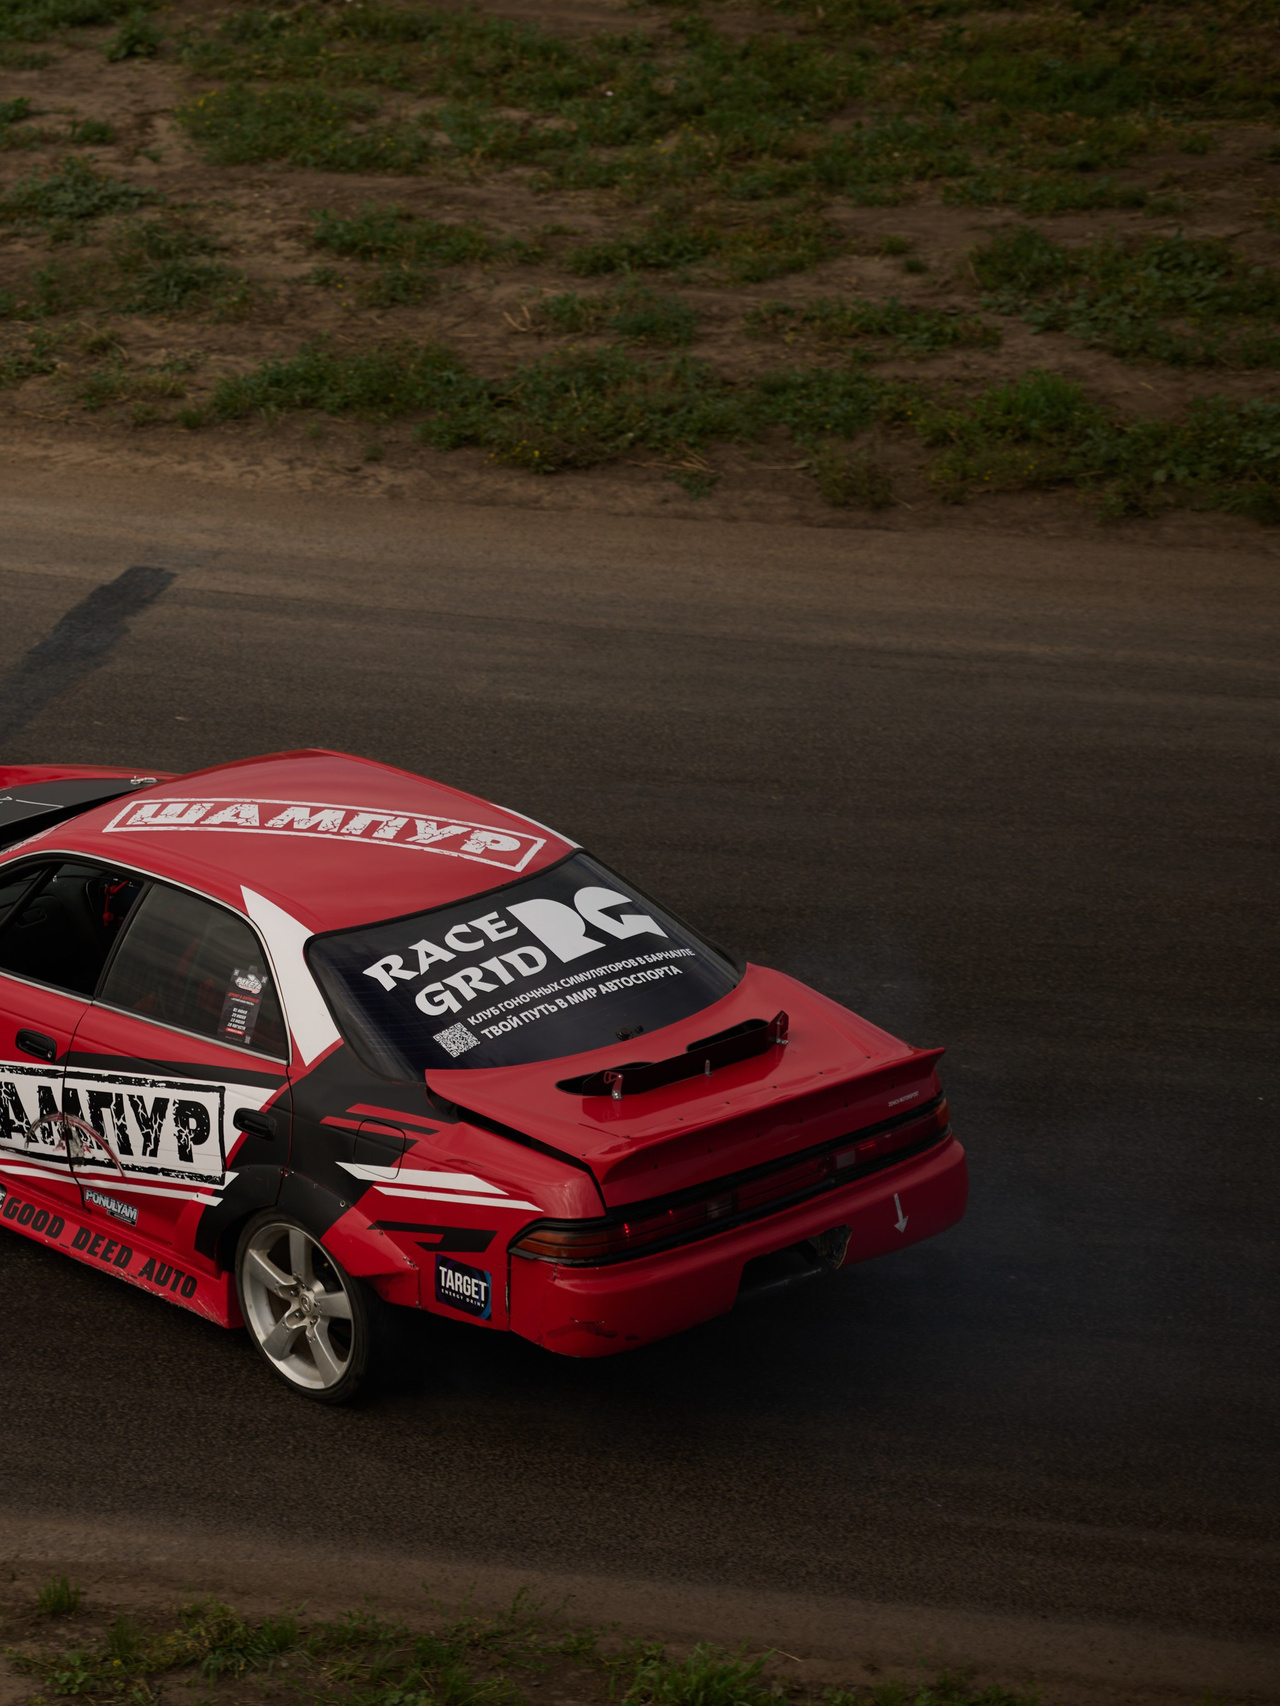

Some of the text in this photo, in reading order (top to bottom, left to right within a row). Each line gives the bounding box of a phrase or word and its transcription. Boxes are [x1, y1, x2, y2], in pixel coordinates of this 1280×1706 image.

[126, 803, 521, 855] ШАМПУР
[362, 911, 519, 992] RACE
[415, 945, 548, 1017] GRID
[467, 948, 696, 1026] КЛУБ ГОНОЧНЫХ СИМУЛЯТОРОВ В БАРНАУЛЕ
[480, 964, 684, 1040] ТВОЙ ПУТЬ В МИР АВТОСПОРТА
[85, 1189, 138, 1221] PONULYAM
[439, 1265, 489, 1302] TARGET
[441, 1288, 485, 1309] ENERGY DRINK
